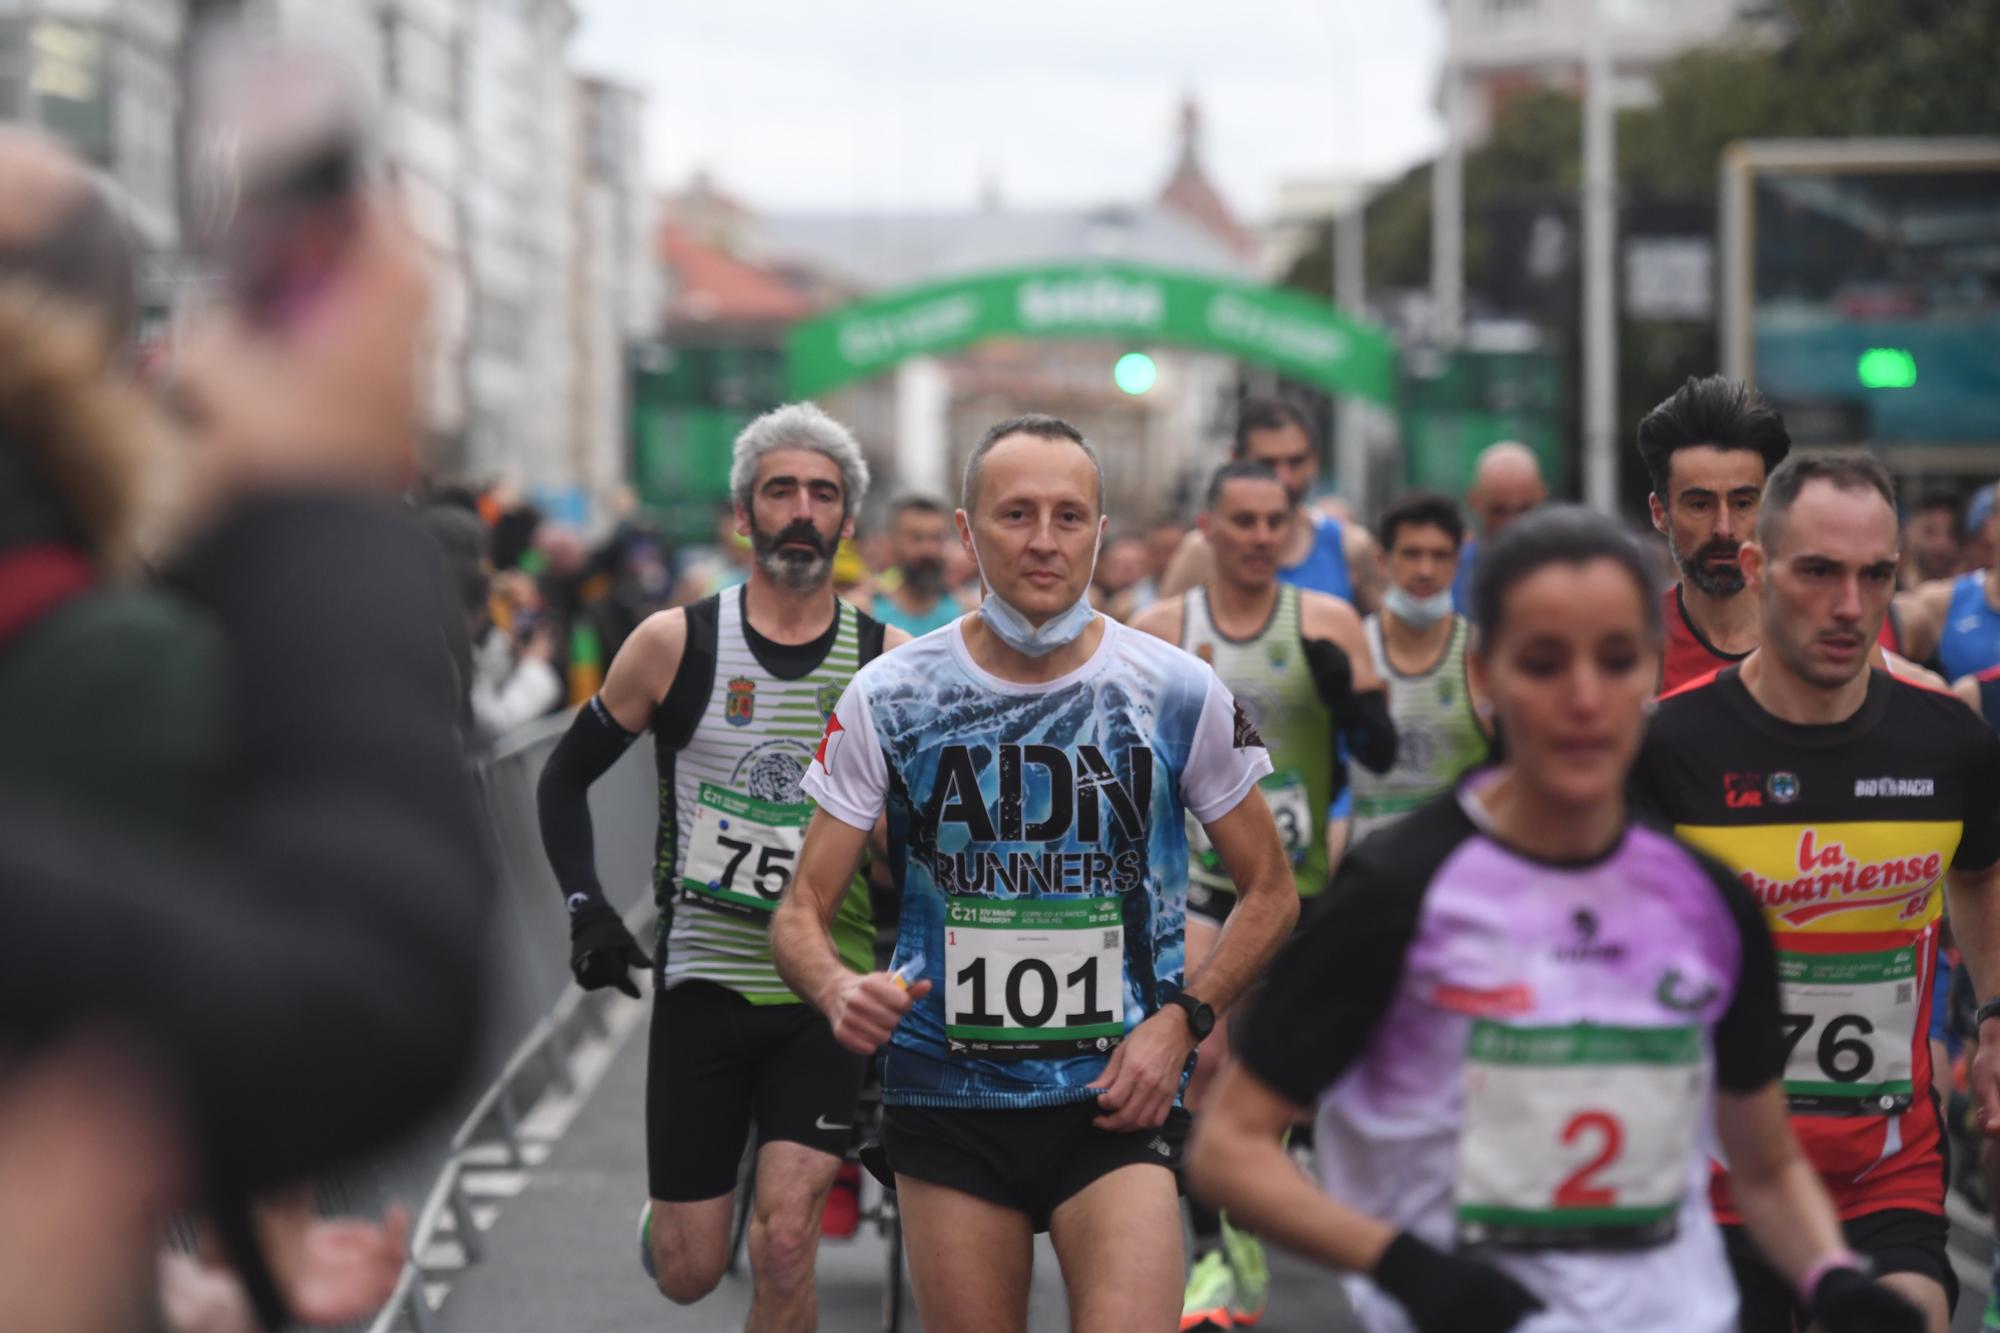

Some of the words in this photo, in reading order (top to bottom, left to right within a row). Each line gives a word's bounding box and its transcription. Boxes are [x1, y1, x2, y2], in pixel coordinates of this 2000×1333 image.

[915, 744, 1152, 842] ADN
[717, 835, 795, 900] 75
[933, 851, 1141, 893] RUNNERS
[1799, 830, 1845, 872] La
[955, 956, 1113, 1027] 101
[1779, 1014, 1874, 1083] 76
[1555, 1110, 1623, 1208] 2
